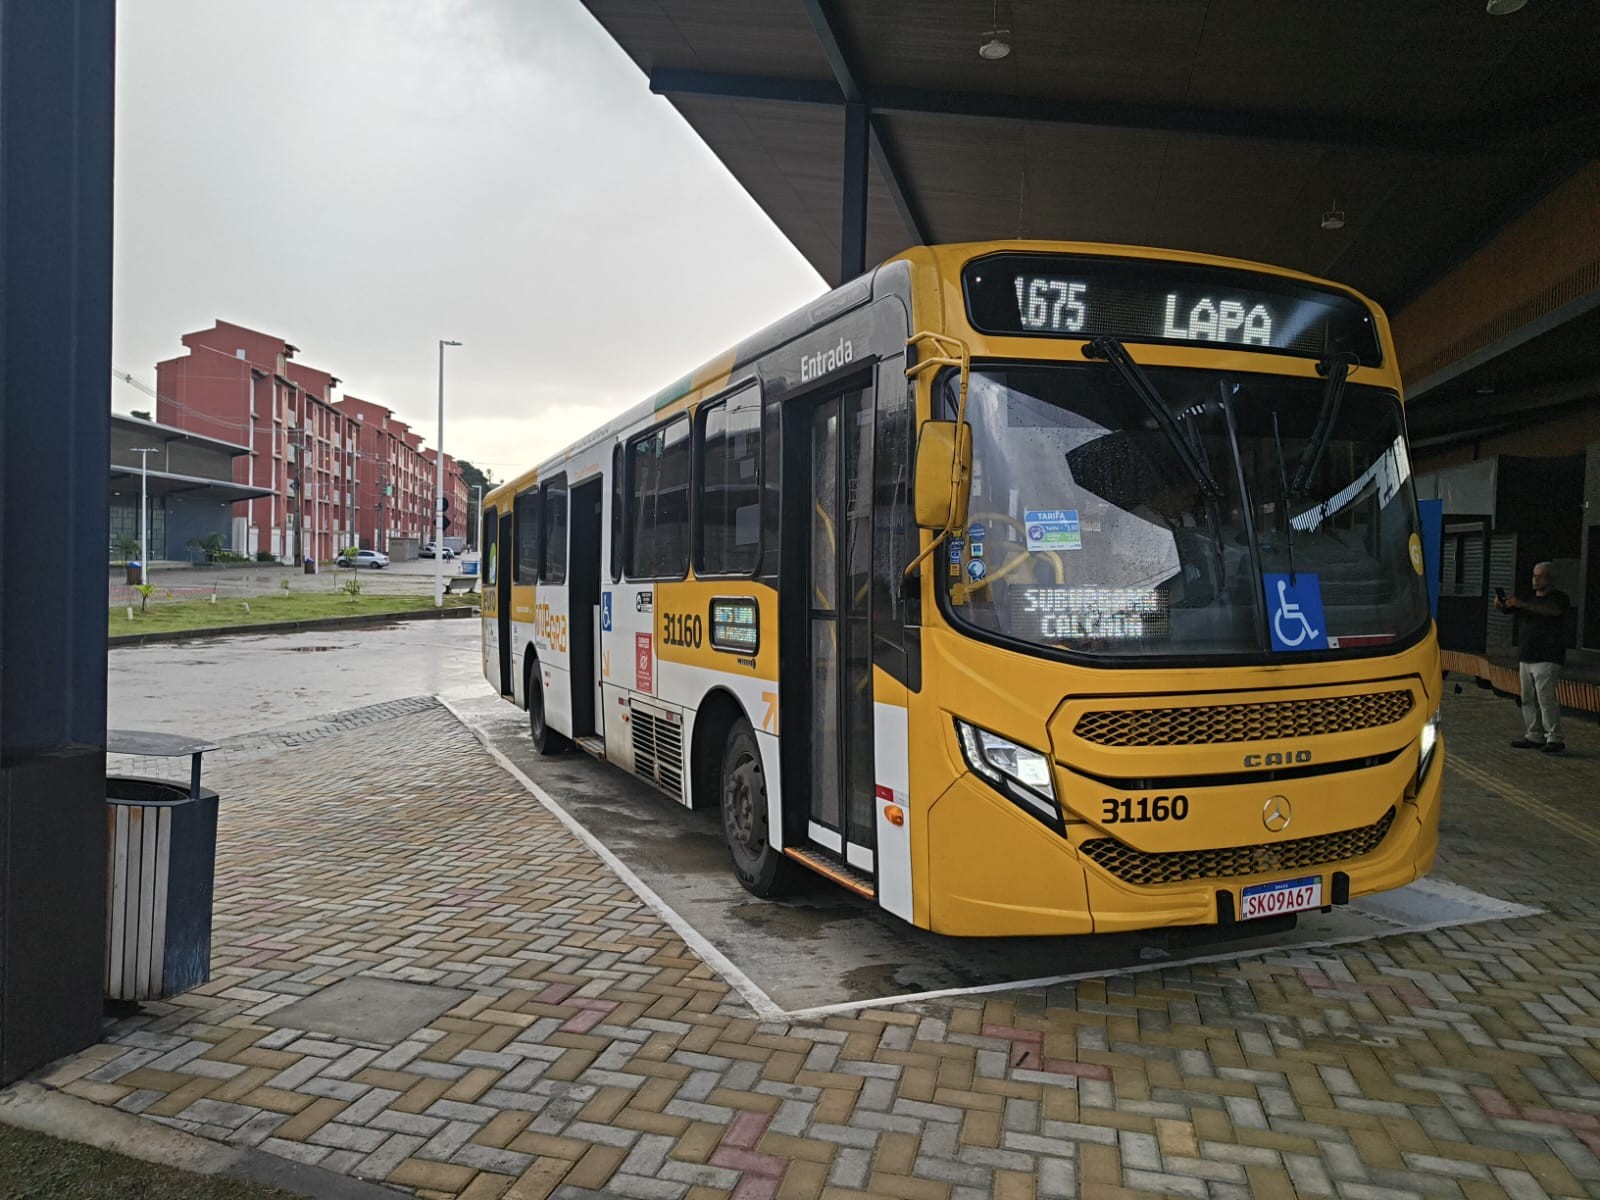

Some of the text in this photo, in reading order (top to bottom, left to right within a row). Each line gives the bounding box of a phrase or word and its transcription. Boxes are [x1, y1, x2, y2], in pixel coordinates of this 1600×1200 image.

[1163, 294, 1272, 347] LAPA
[801, 336, 853, 384] Entrada
[1037, 511, 1066, 521] TARIFA
[663, 612, 703, 649] 31160
[1243, 750, 1312, 768] CAIO
[1101, 795, 1189, 824] 31160
